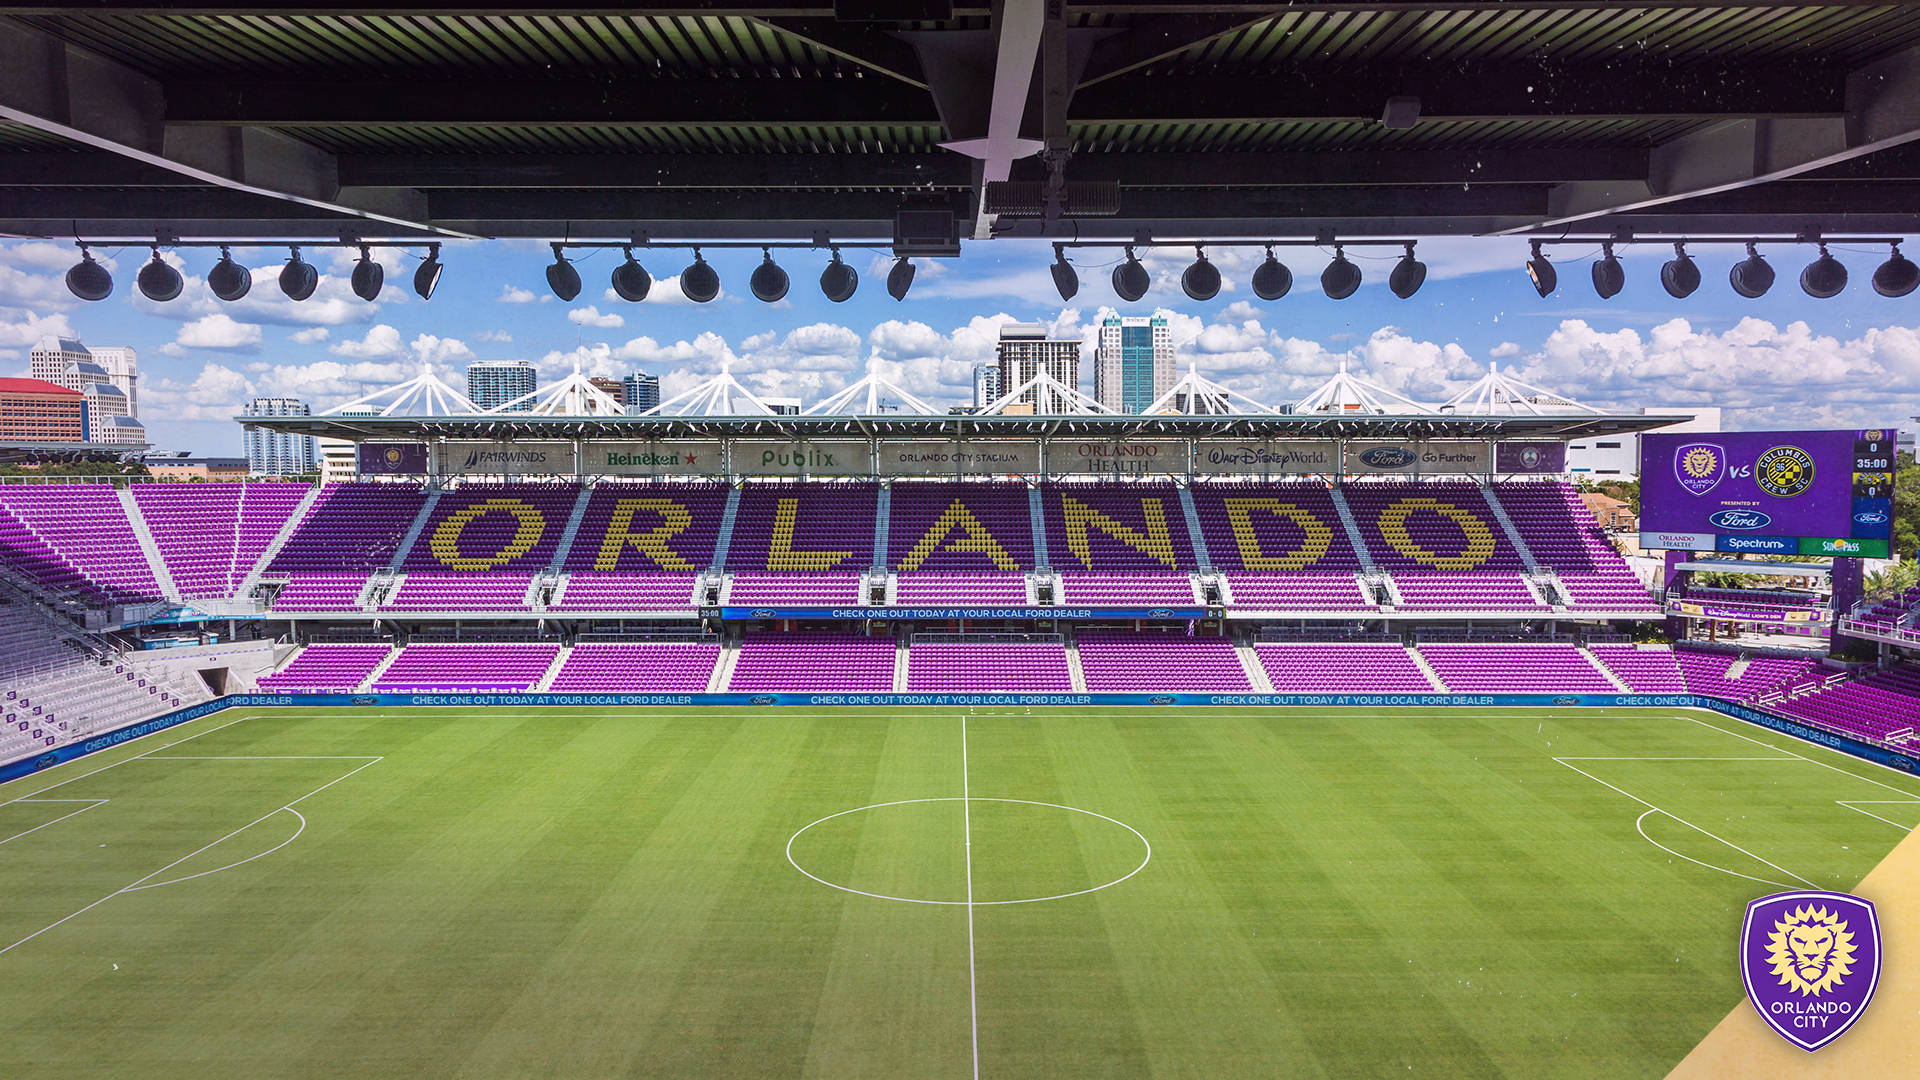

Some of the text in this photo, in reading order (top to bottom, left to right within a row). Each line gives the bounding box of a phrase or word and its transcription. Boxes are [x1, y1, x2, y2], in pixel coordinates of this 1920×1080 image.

[1079, 443, 1158, 457] ORLANDO
[1870, 443, 1878, 453] 0
[478, 451, 546, 463] FAIRWINDS
[607, 451, 679, 466] Heineken
[762, 449, 834, 467] Publix
[900, 454, 1019, 463] ORLANDO CITY STADIUM
[1422, 453, 1437, 463] Go
[1439, 453, 1476, 463] Further
[1760, 449, 1811, 469] COLUMBUS
[1088, 459, 1149, 472] HEALTH
[1775, 463, 1786, 472] 96
[1857, 459, 1888, 469] 35:00
[1760, 477, 1809, 494] CREW SC
[1868, 487, 1876, 496] 0
[1720, 512, 1759, 527] Ford
[430, 493, 1497, 571] ORLANDO
[1658, 534, 1695, 542] ORLANDO
[1729, 538, 1780, 550] Spectrum
[700, 609, 719, 617] 35:00
[832, 609, 1091, 618] CHECK ONE OUT TODAY AT YOUR LOCAL FORD DEALER
[412, 696, 691, 705] CHECK ONE OUT TODAY AT YOUR LOCAL FORD DEALER
[811, 695, 1091, 704] CHECK ONE OUT TODAY AT YOUR LOCAL FORD DEALER
[1211, 695, 1493, 705] CHECK ONE OUT TODAY AT YOUR LOCAL FORD DEALER
[85, 696, 293, 752] CHECK ONE OUT TODAY AT YOUR LOCAL FORD DEALER
[1616, 696, 1841, 748] CHECK ONE OUT TODAY AT YOUR LOCAL FORD DEALER
